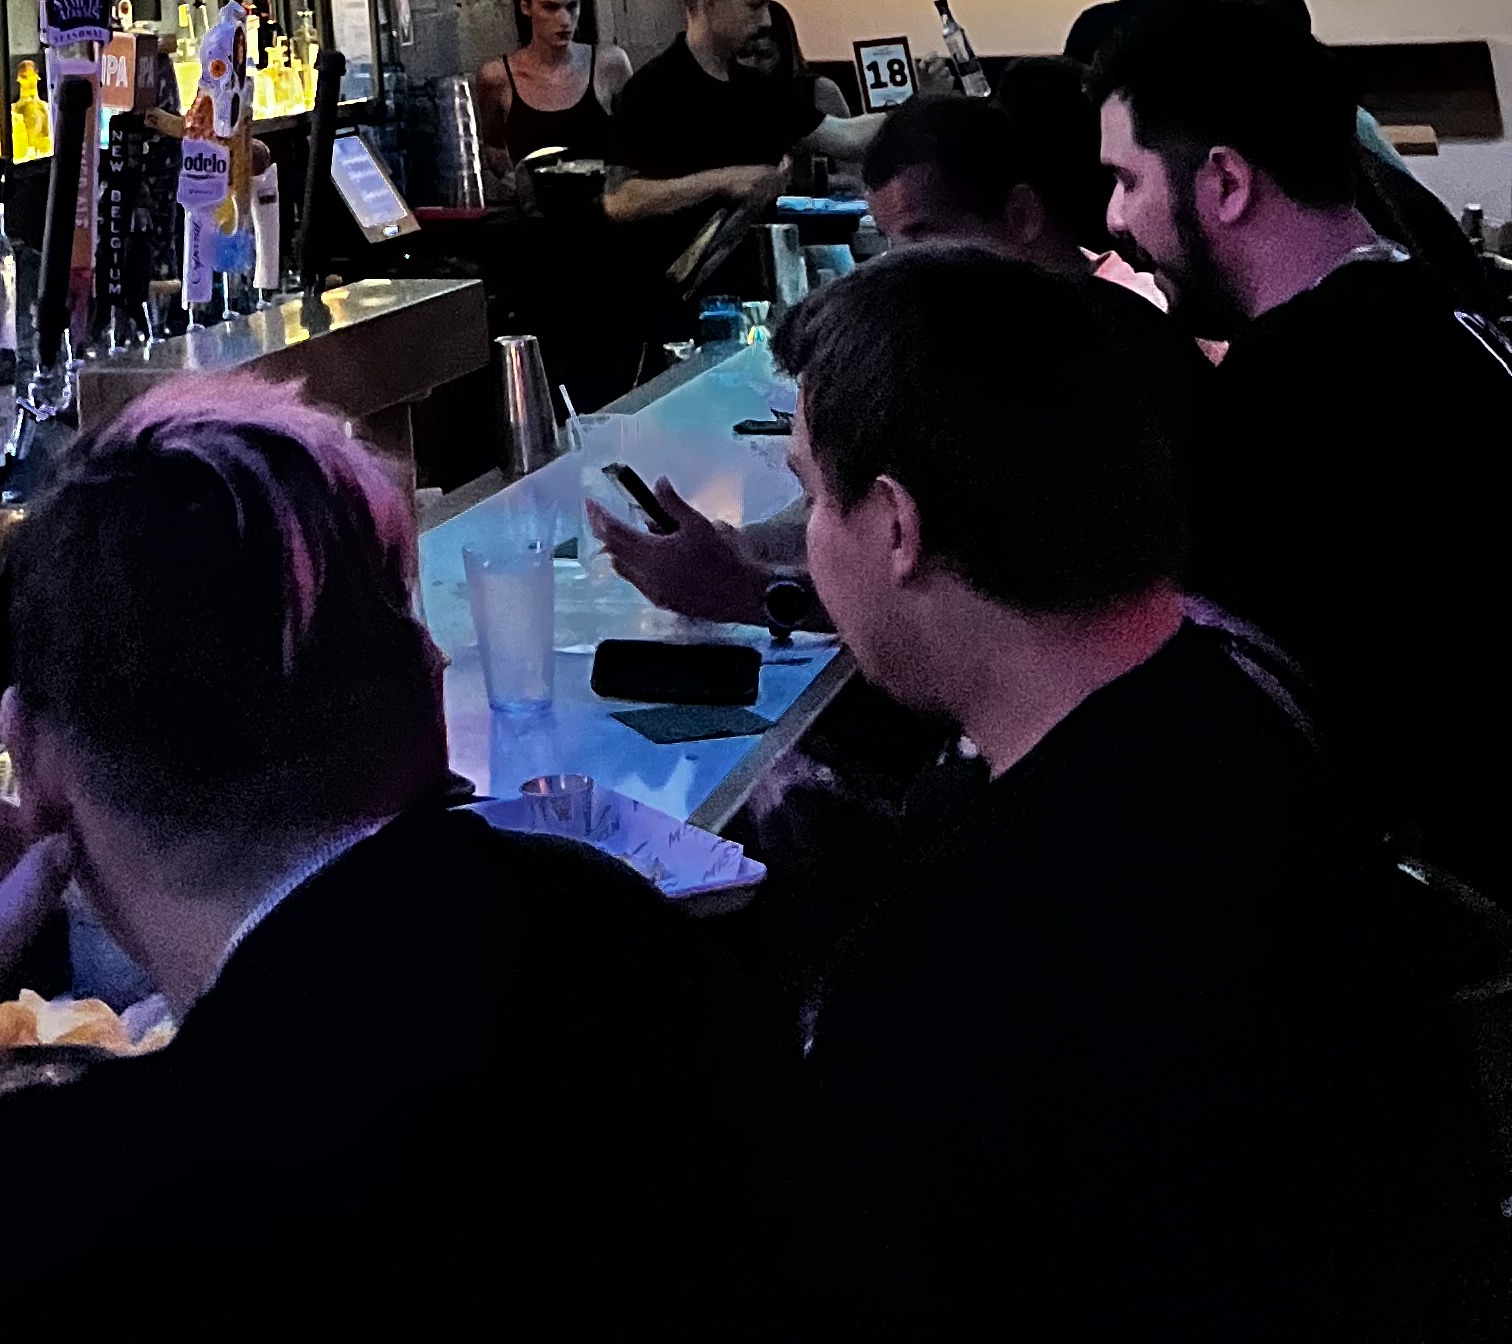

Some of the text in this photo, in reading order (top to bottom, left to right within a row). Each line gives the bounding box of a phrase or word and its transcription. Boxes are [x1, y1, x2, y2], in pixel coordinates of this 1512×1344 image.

[59, 7, 102, 21] ADAMS
[101, 54, 129, 88] IPA
[866, 58, 908, 89] 18
[184, 152, 227, 174] odelo
[108, 130, 125, 295] NEW BELGIUM
